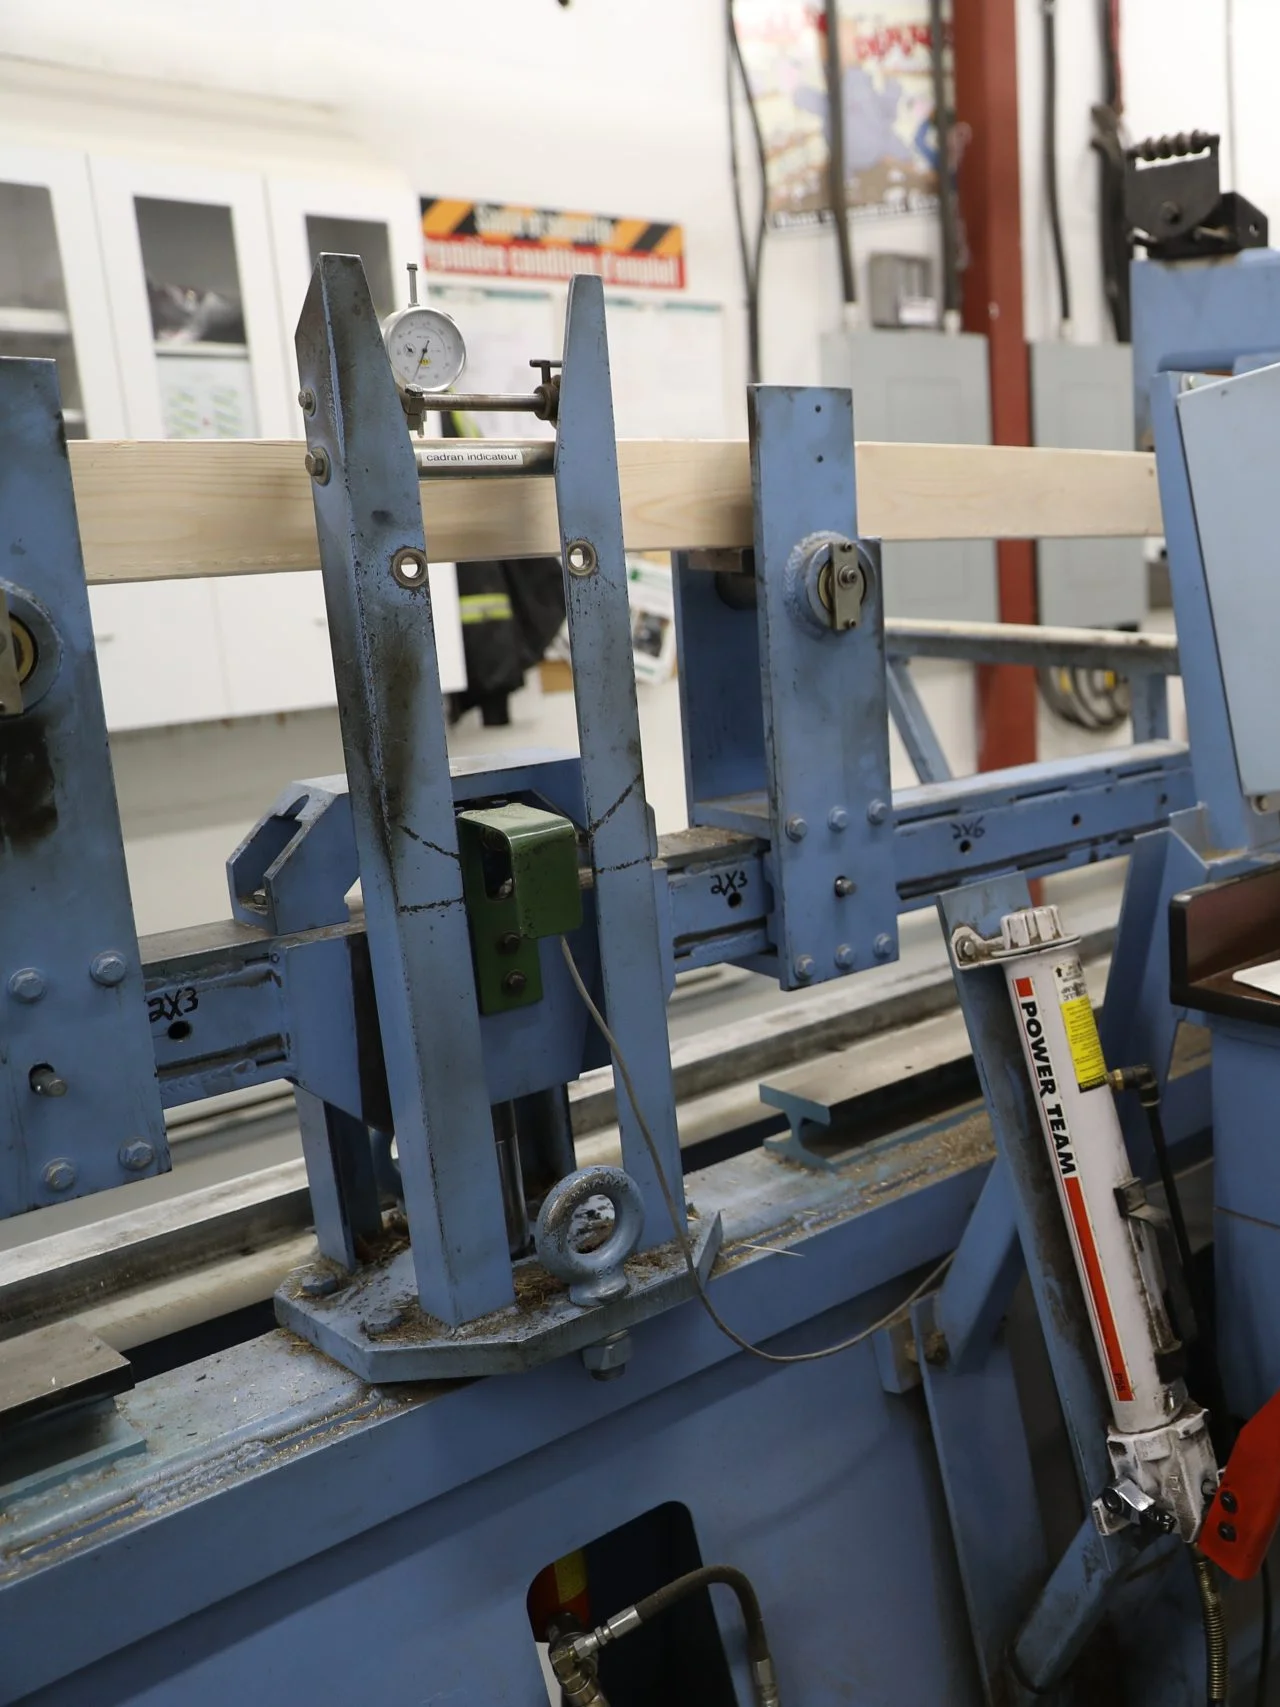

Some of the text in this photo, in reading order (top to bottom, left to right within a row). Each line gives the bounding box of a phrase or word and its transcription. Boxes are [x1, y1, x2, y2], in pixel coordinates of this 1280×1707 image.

[426, 453, 518, 462] cadran indicateur
[147, 987, 199, 1024] 2X3
[1021, 1001, 1076, 1175] POWER TEAM
